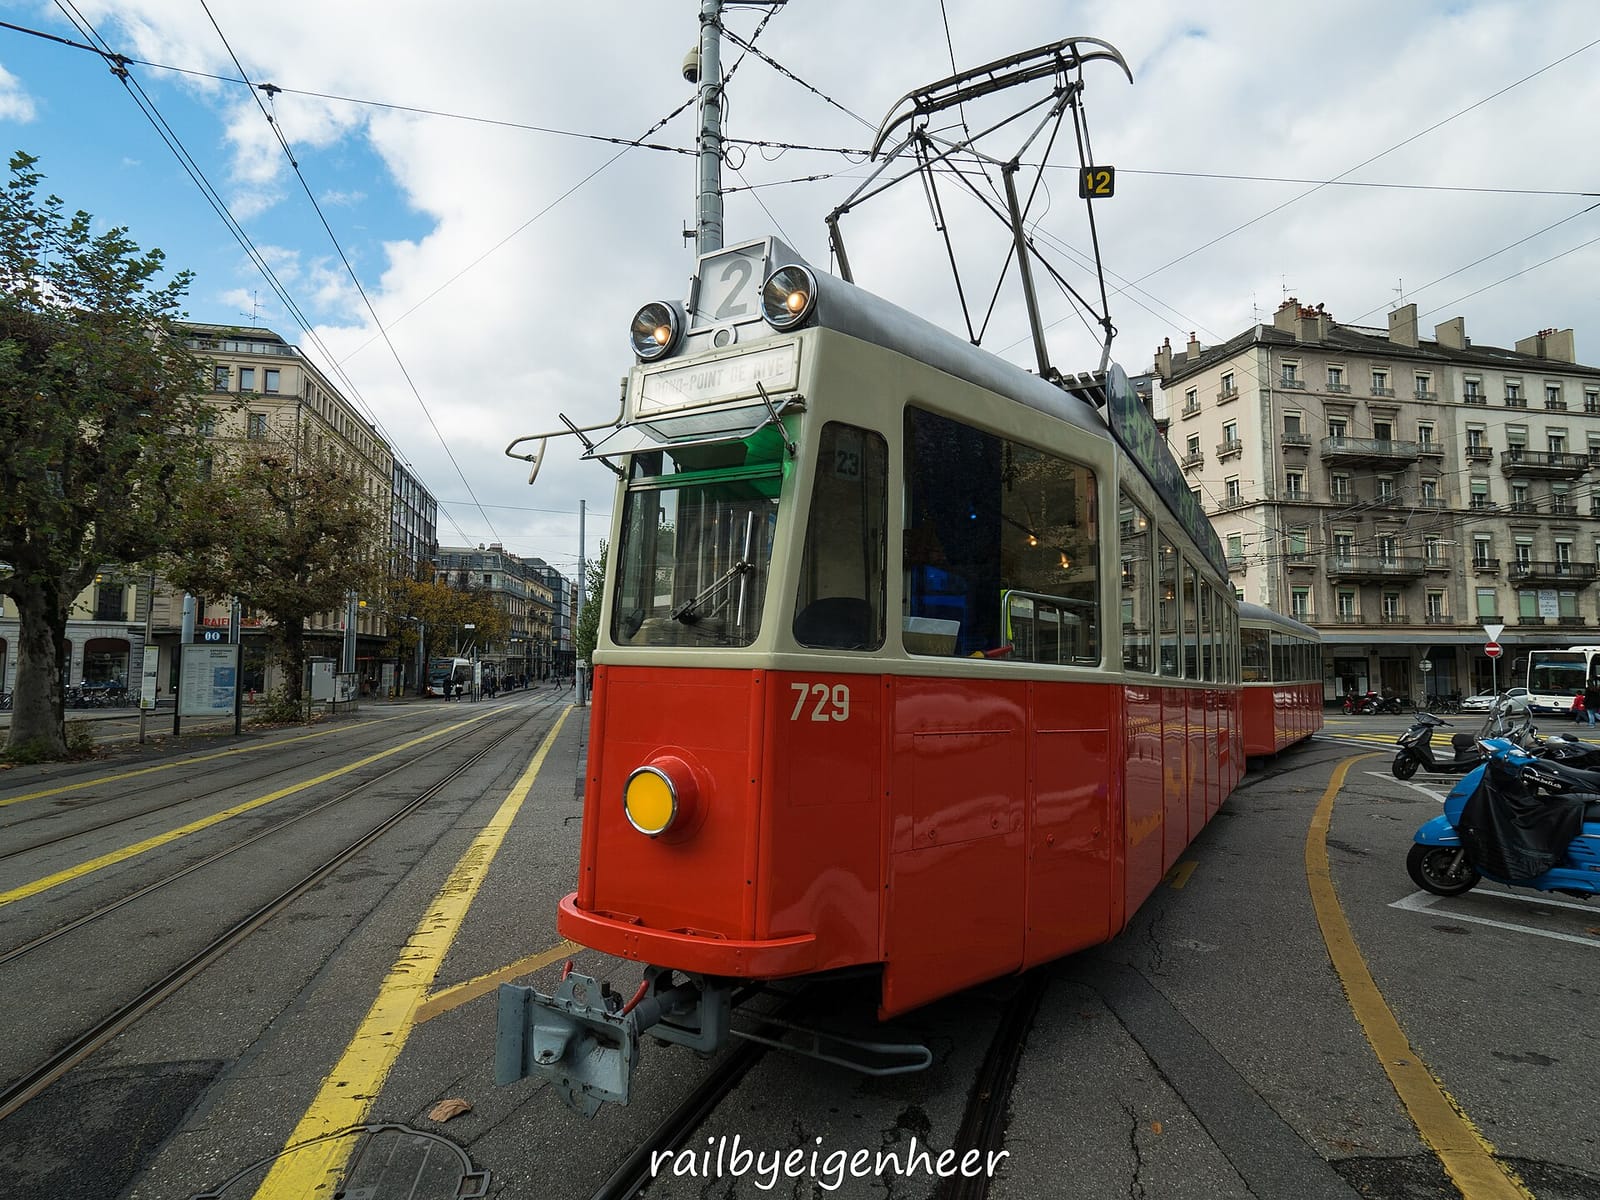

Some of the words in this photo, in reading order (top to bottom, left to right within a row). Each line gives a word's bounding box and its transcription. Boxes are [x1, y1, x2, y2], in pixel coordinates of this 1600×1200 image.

[1086, 171, 1111, 194] 12
[715, 258, 753, 319] 2
[836, 450, 859, 476] 23
[790, 682, 850, 722] 729
